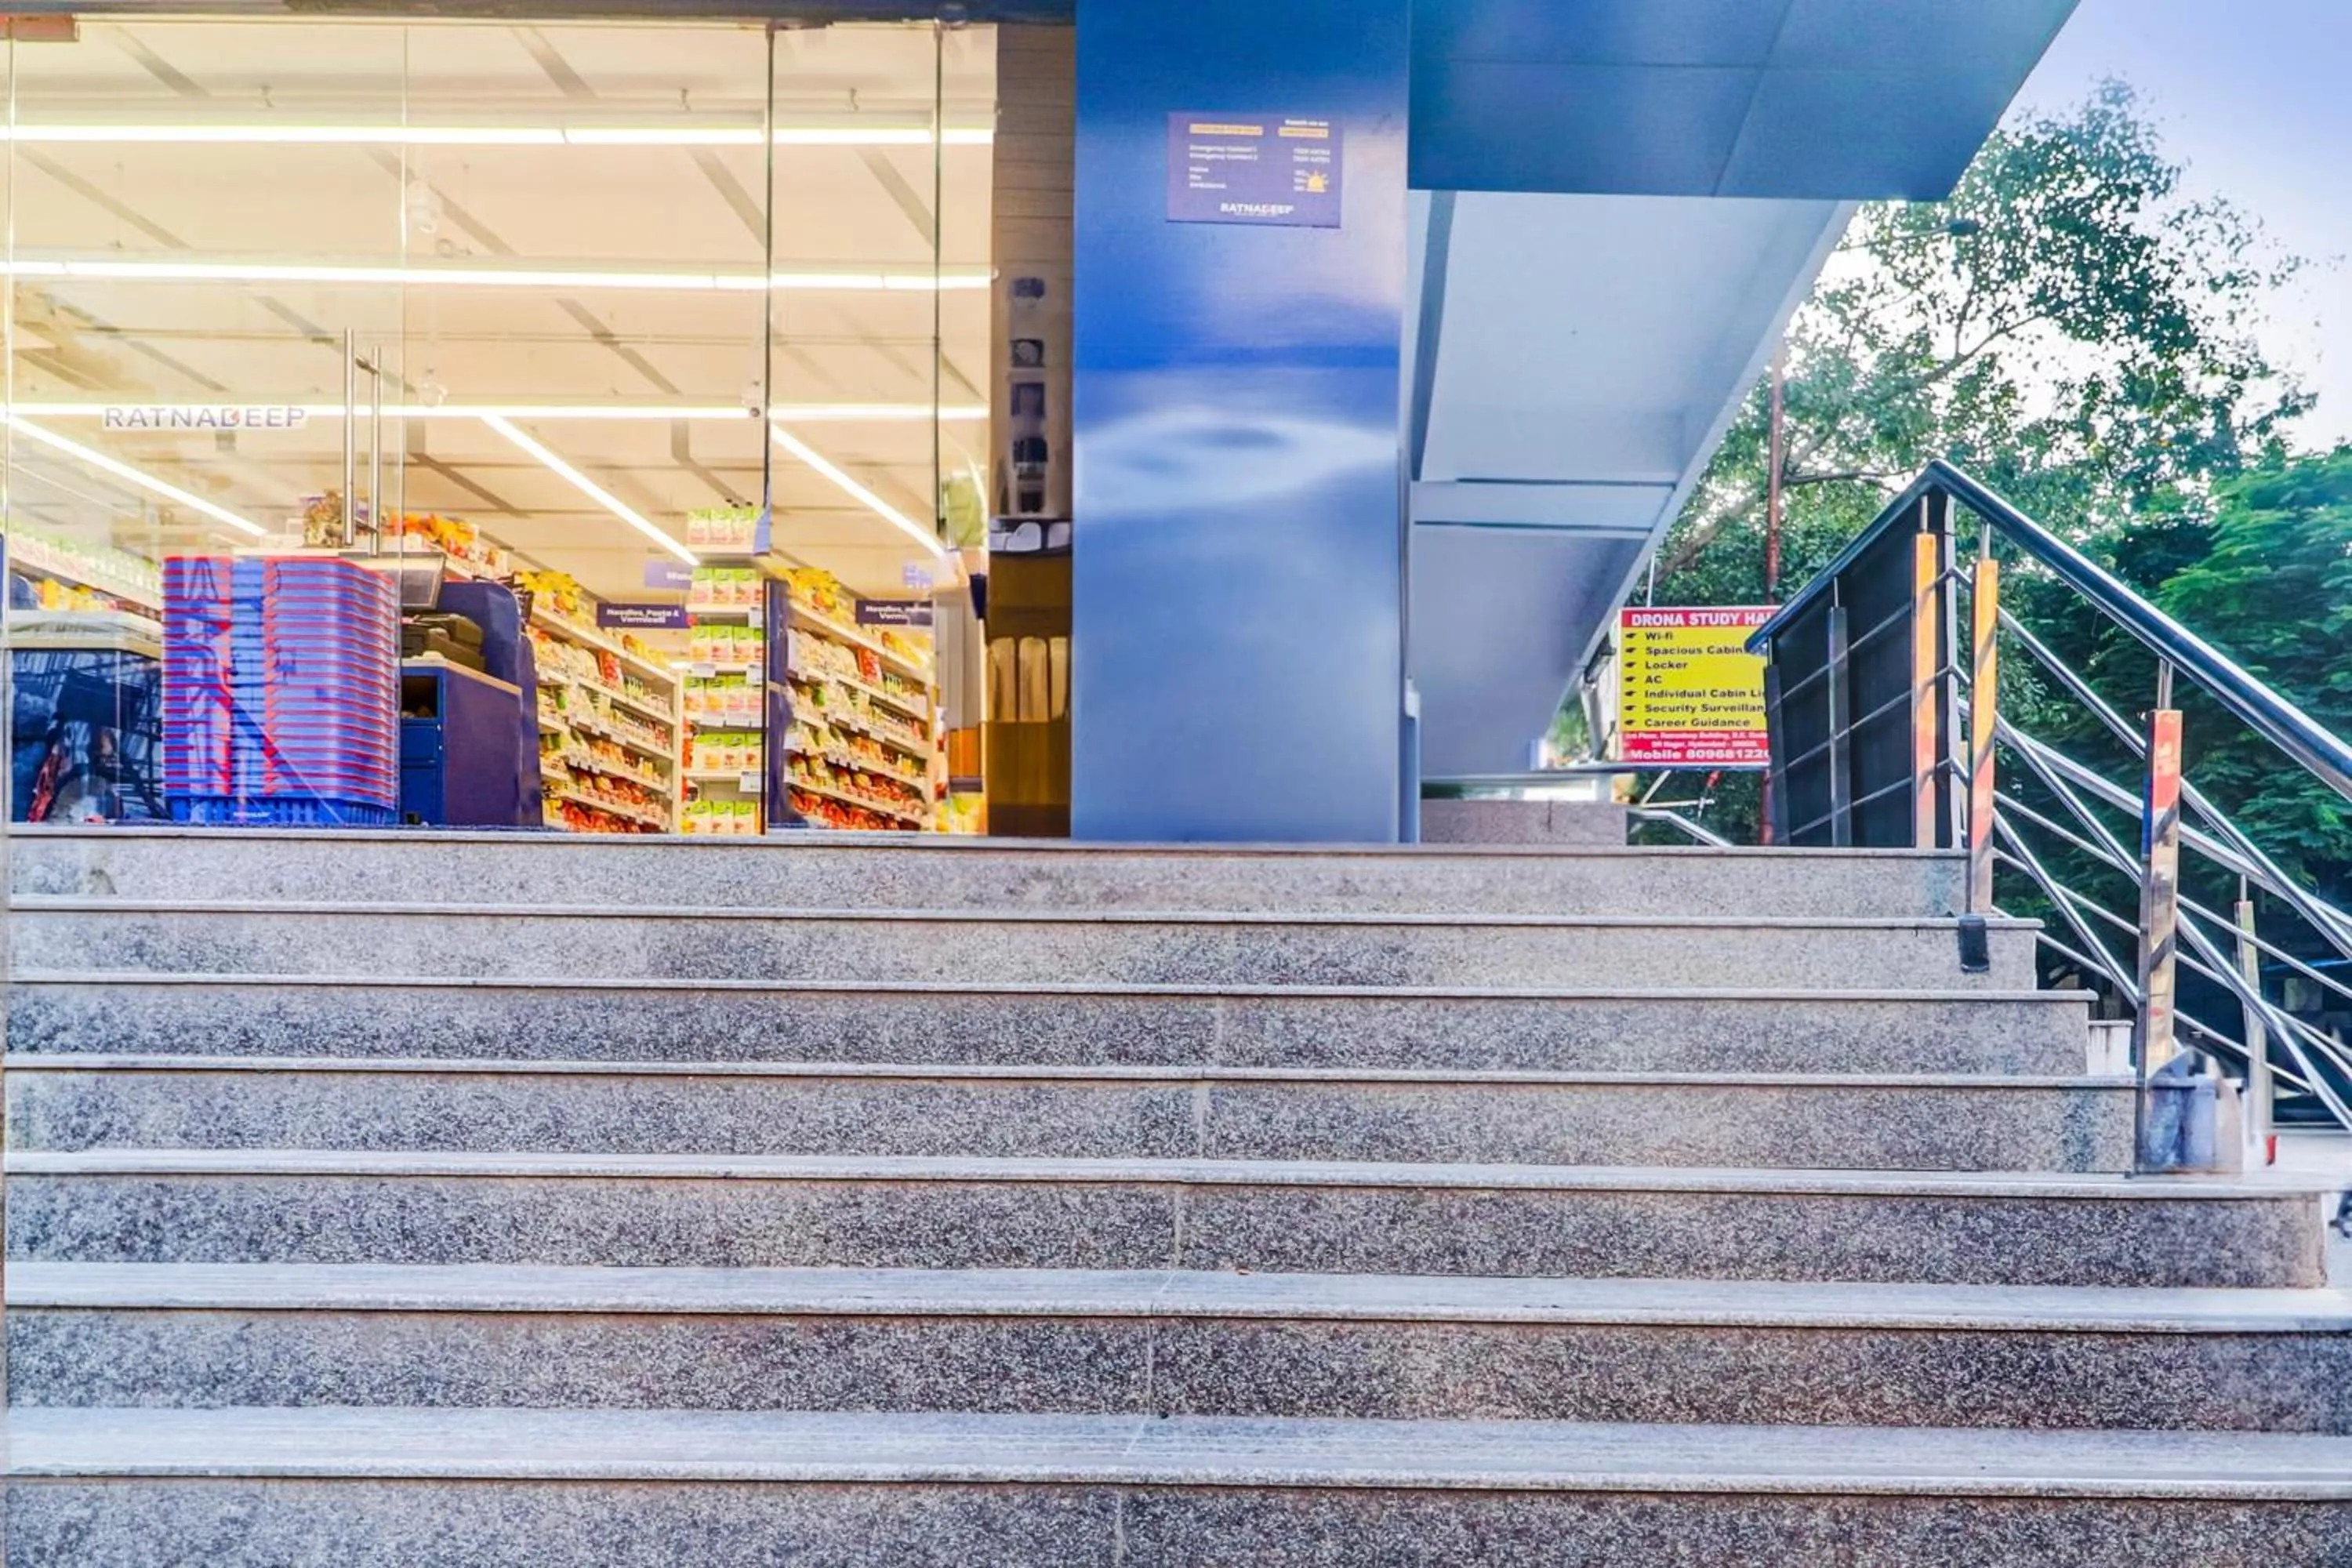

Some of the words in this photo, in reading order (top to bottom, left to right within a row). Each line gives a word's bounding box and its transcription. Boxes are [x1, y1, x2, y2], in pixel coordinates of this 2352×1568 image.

[1221, 203, 1294, 215] RATNADEEP
[105, 407, 305, 427] RATNADEEP
[1632, 614, 1684, 626] DRONA
[1689, 613, 1740, 625] STUDY
[1645, 647, 1702, 656] Spacious
[1645, 705, 1697, 713] Security
[1632, 750, 1682, 759] Mobile
